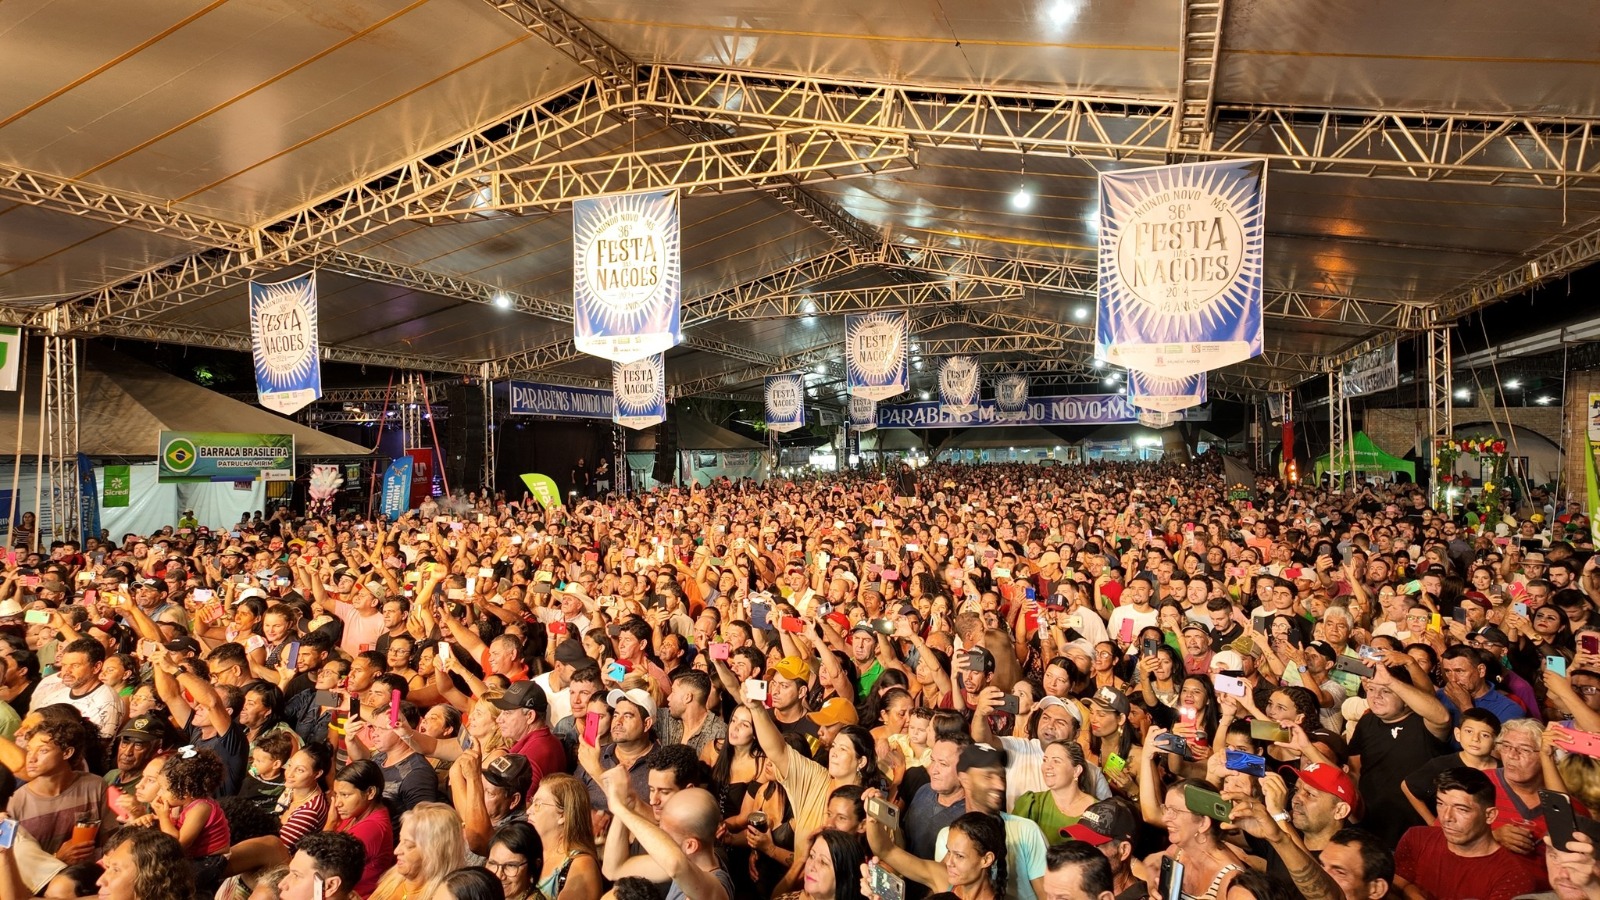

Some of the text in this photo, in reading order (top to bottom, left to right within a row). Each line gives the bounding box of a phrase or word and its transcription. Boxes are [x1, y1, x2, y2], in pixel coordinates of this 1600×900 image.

[1134, 190, 1228, 218] MUNDO NOVO MS
[596, 216, 618, 235] MUNDO
[620, 214, 638, 222] NOVO
[1135, 217, 1228, 255] FESTA
[597, 234, 656, 266] FESTA
[1134, 254, 1229, 287] NAÇÕES
[261, 308, 302, 336] FESTA
[624, 368, 654, 384] FESTA
[570, 392, 600, 412] MUNDO
[200, 447, 288, 457] BARRACA BRASILEIRA
[104, 488, 129, 496] Sicredi
[392, 484, 400, 510] MIRIM
